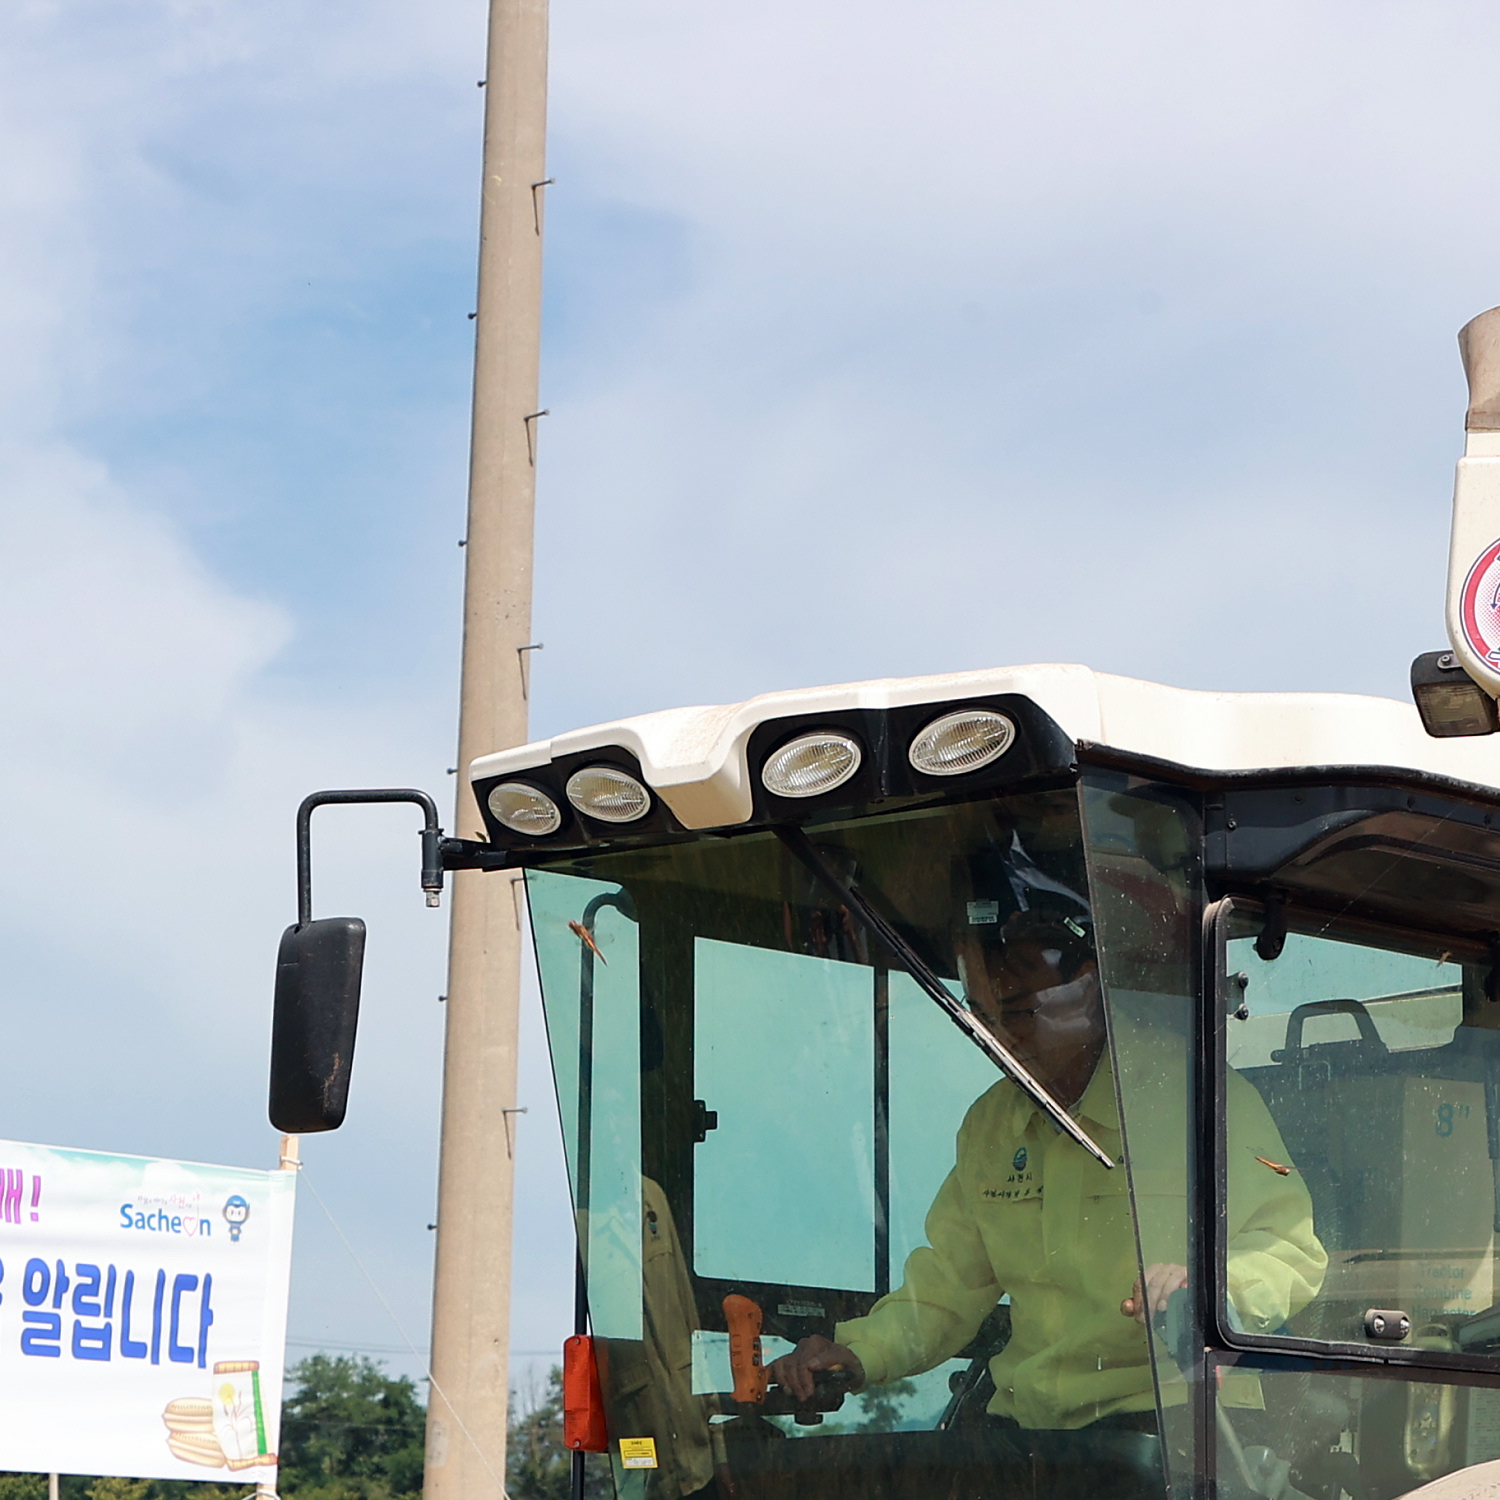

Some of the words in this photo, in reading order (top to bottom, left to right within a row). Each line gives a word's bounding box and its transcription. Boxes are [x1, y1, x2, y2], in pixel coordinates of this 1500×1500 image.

[1420, 1262, 1465, 1279] Tractor
[1414, 1283, 1472, 1300] Combine
[21, 1258, 213, 1368] 알립니다
